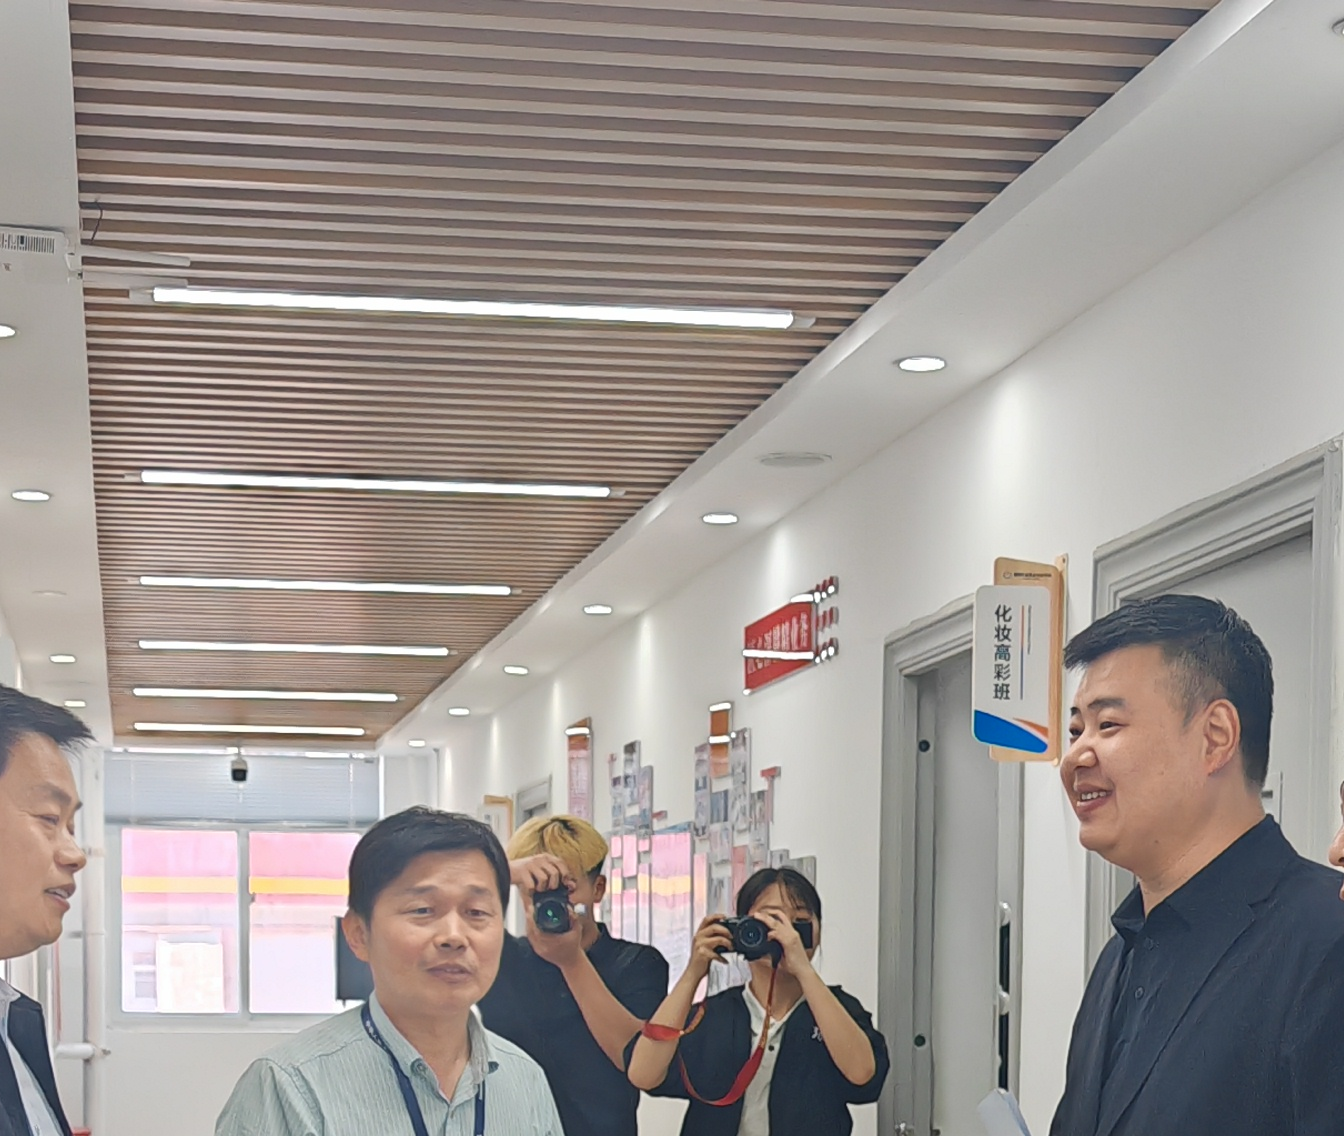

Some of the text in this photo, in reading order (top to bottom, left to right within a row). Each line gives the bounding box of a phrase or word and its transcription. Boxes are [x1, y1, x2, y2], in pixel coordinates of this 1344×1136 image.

[993, 604, 1012, 700] 化妆高彩班
